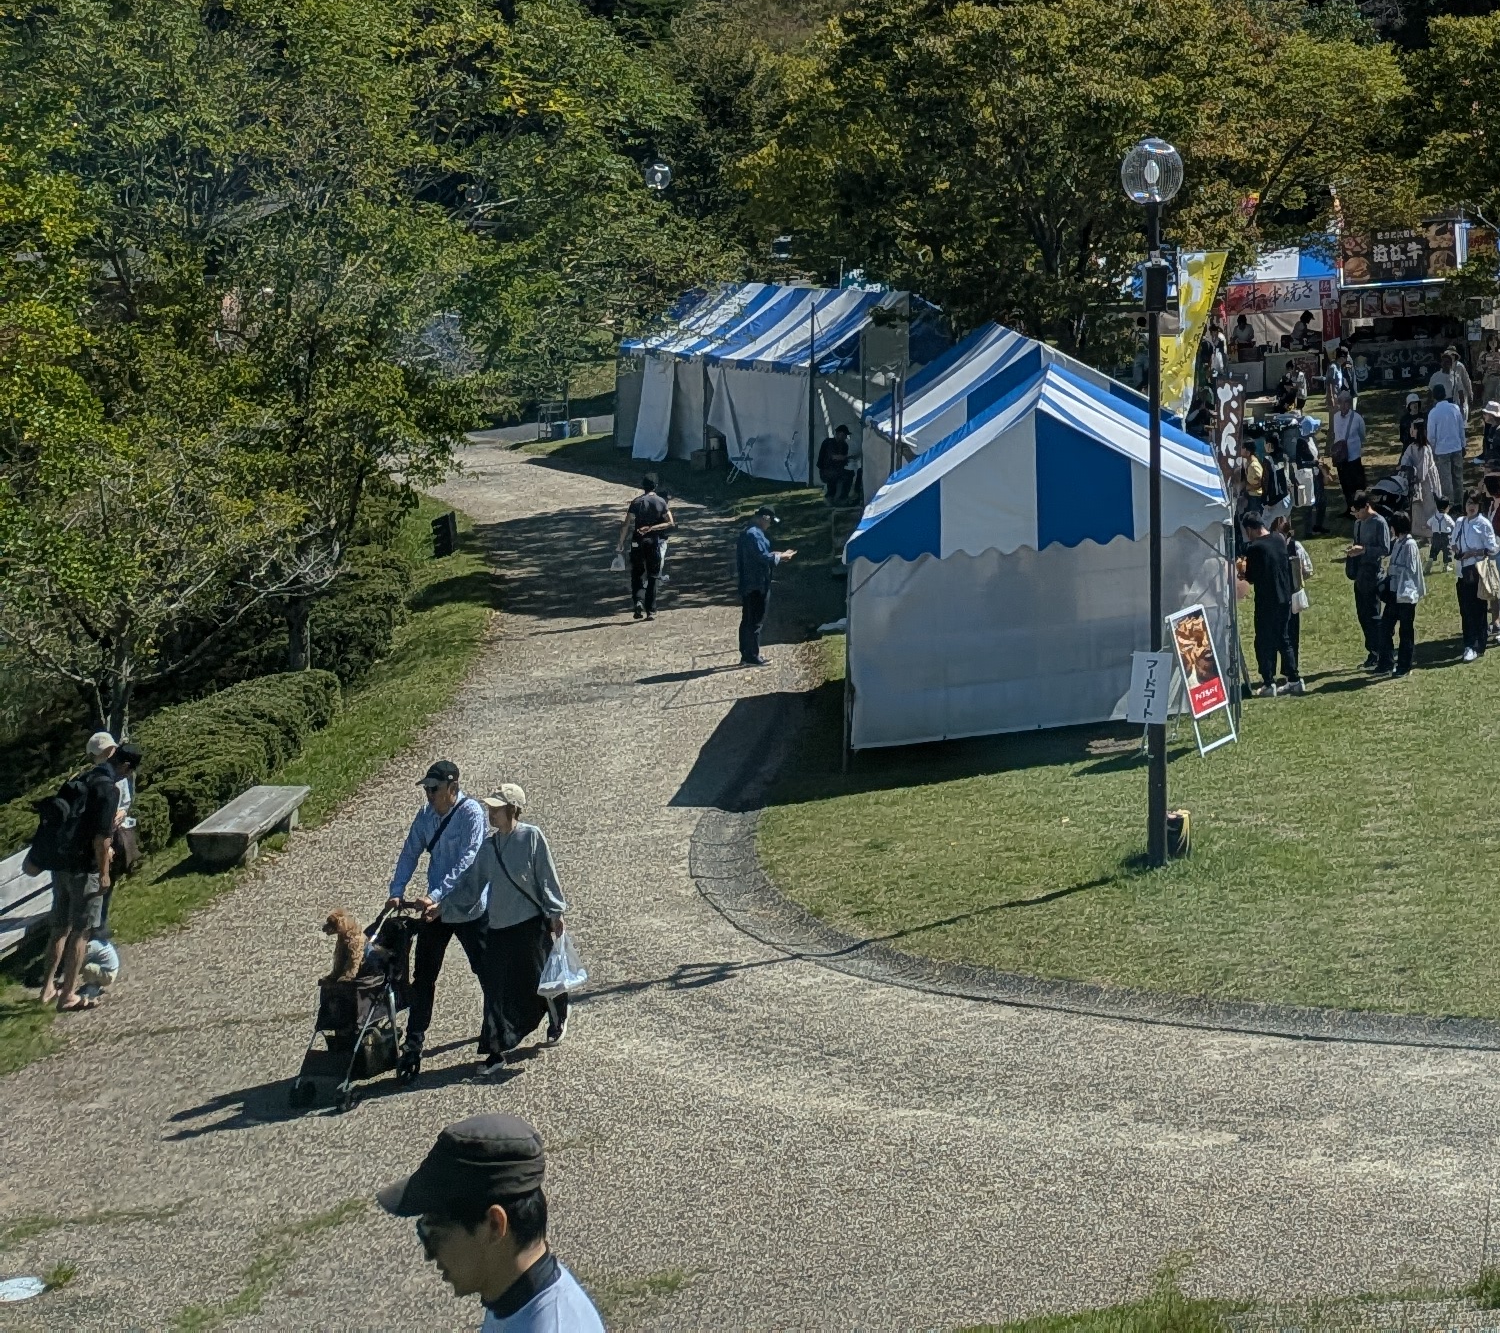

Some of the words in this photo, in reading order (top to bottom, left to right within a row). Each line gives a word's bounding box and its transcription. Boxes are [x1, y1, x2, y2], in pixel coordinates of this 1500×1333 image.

[1372, 241, 1423, 263] 近江牛
[1143, 659, 1159, 719] フードコート
